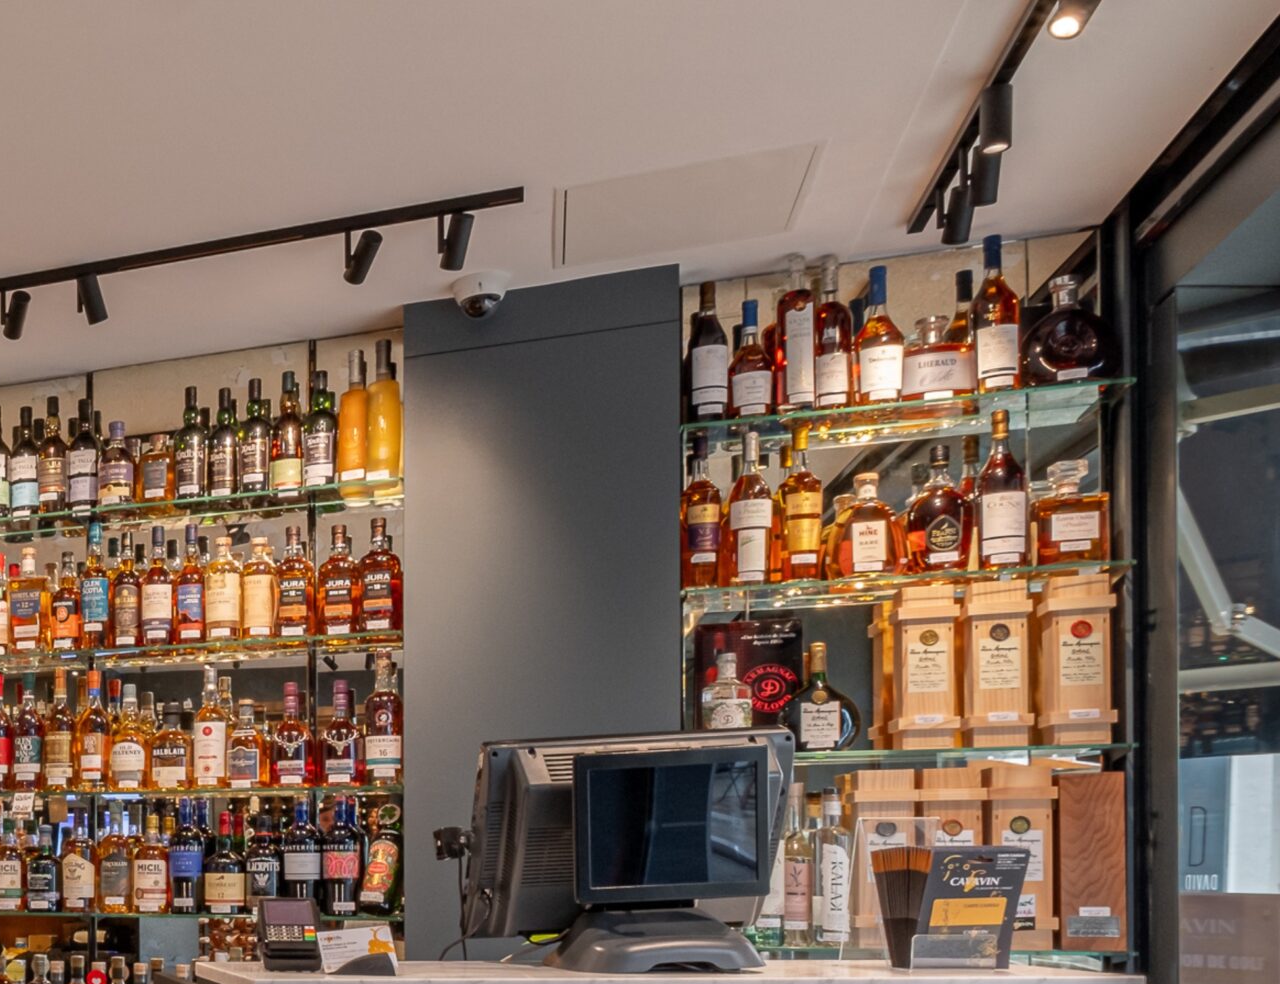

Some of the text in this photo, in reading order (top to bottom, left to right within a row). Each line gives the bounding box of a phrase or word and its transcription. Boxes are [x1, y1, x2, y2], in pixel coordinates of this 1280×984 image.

[364, 573, 391, 581] JURA
[82, 580, 101, 588] GLEN
[281, 580, 306, 588] JURA
[325, 580, 352, 588] JURA
[379, 748, 388, 757] 16
[137, 863, 162, 872] MICIL
